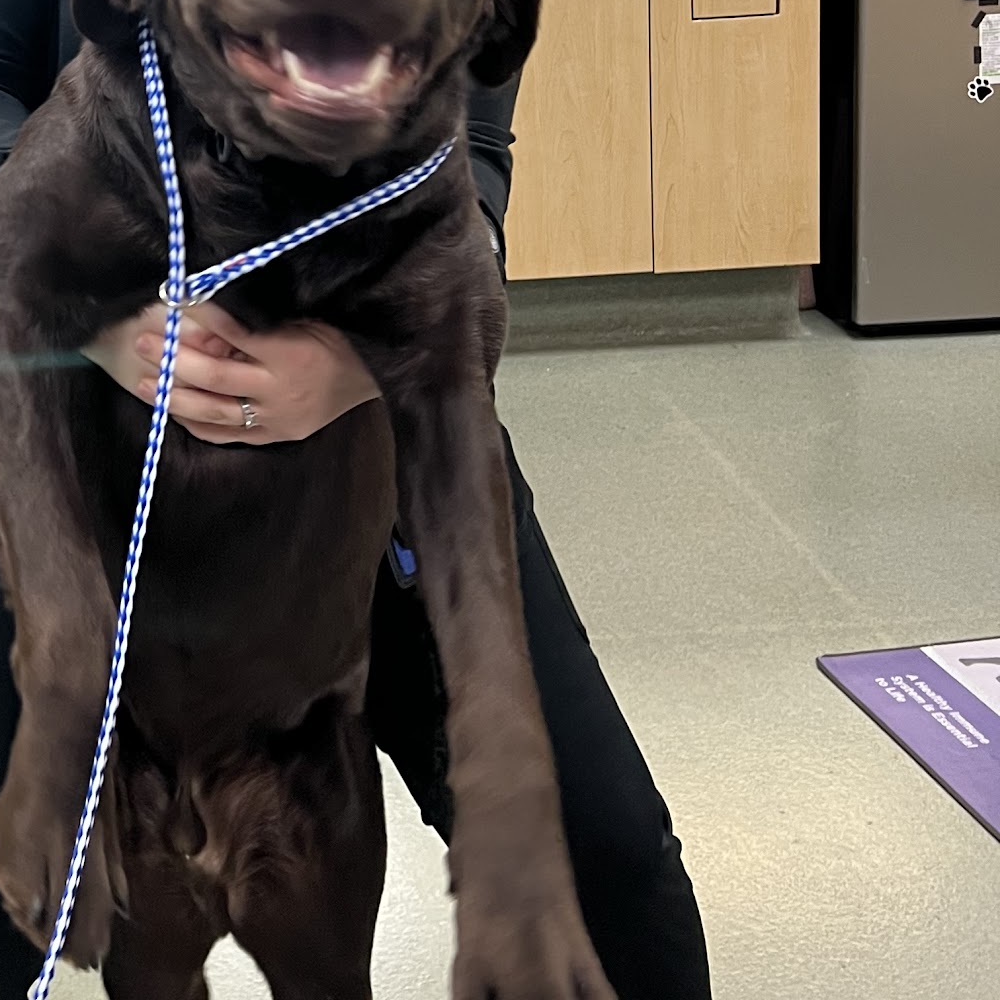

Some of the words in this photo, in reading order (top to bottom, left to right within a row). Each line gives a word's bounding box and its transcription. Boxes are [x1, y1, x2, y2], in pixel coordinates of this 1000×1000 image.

[874, 677, 889, 687] to
[885, 687, 907, 703] Life
[890, 676, 926, 704] System
[931, 712, 979, 749] Essential
[914, 681, 953, 711] Healthy
[949, 711, 990, 744] Immune
